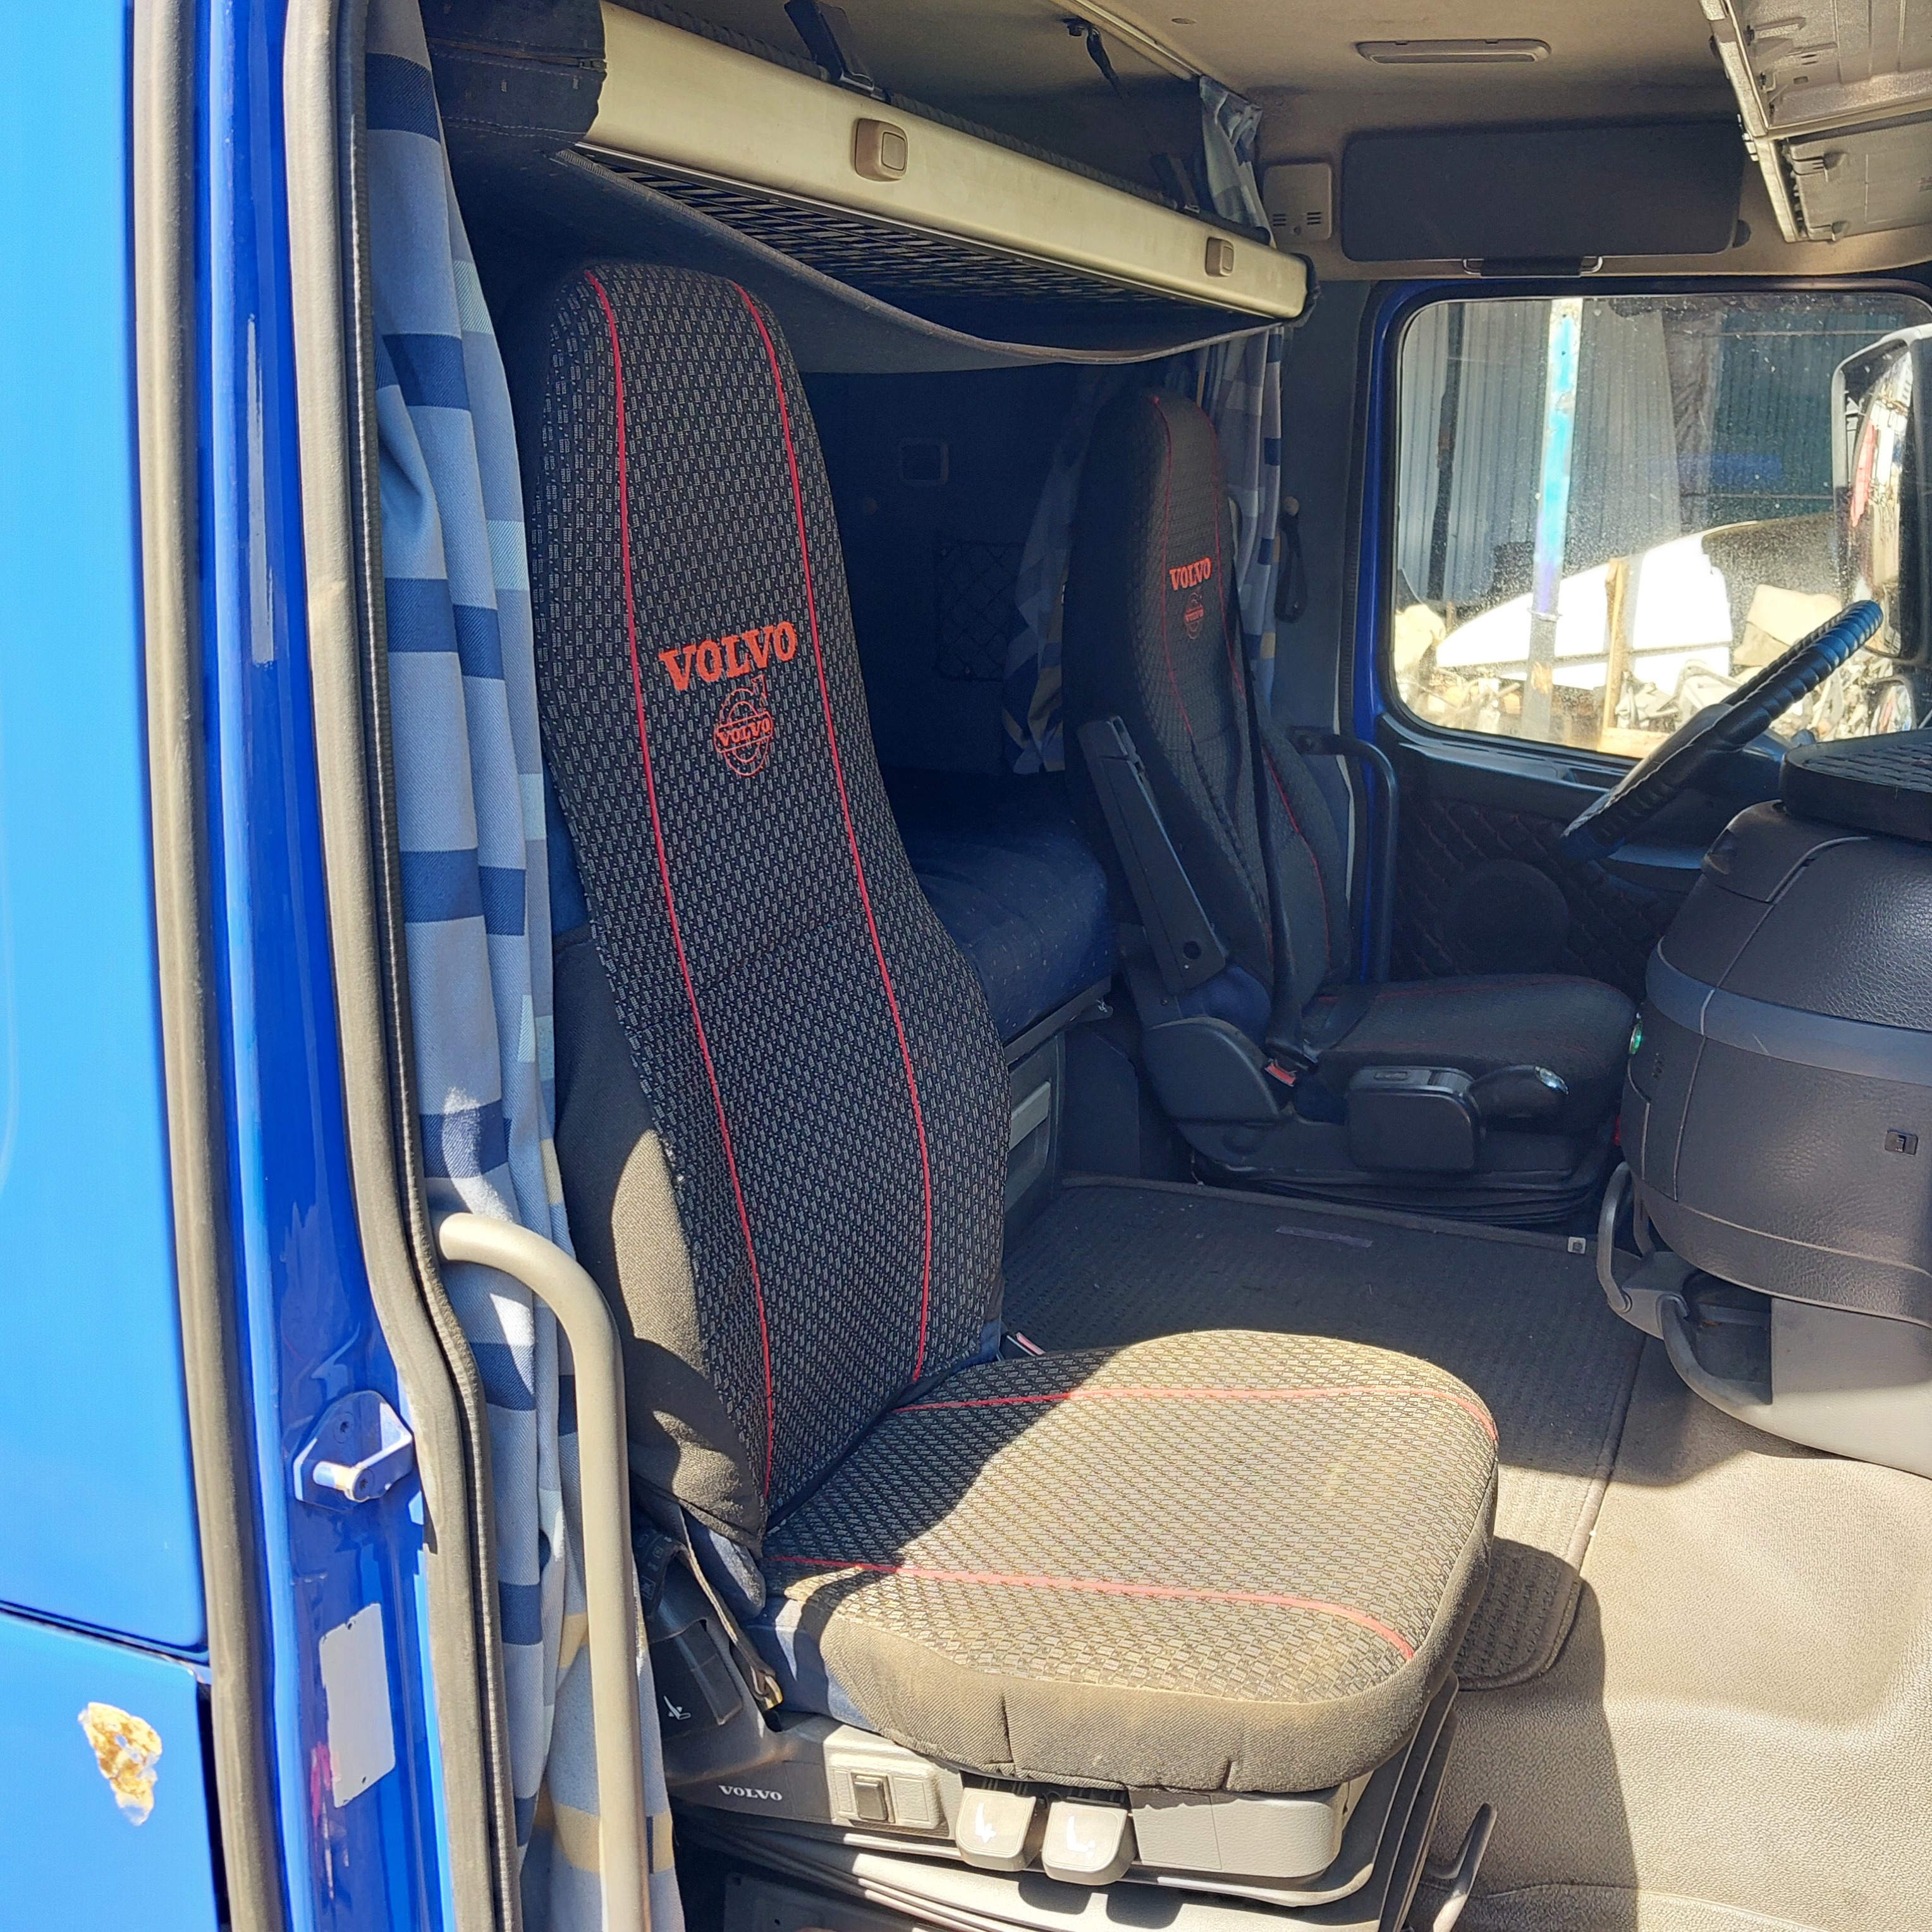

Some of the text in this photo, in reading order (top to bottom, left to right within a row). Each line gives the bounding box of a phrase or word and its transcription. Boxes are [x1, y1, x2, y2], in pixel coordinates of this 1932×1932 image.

[1170, 557, 1212, 591] VOLVO
[657, 621, 797, 690] VOLVO
[717, 718, 771, 747] VOLVO
[718, 1785, 783, 1801] VOLVO
